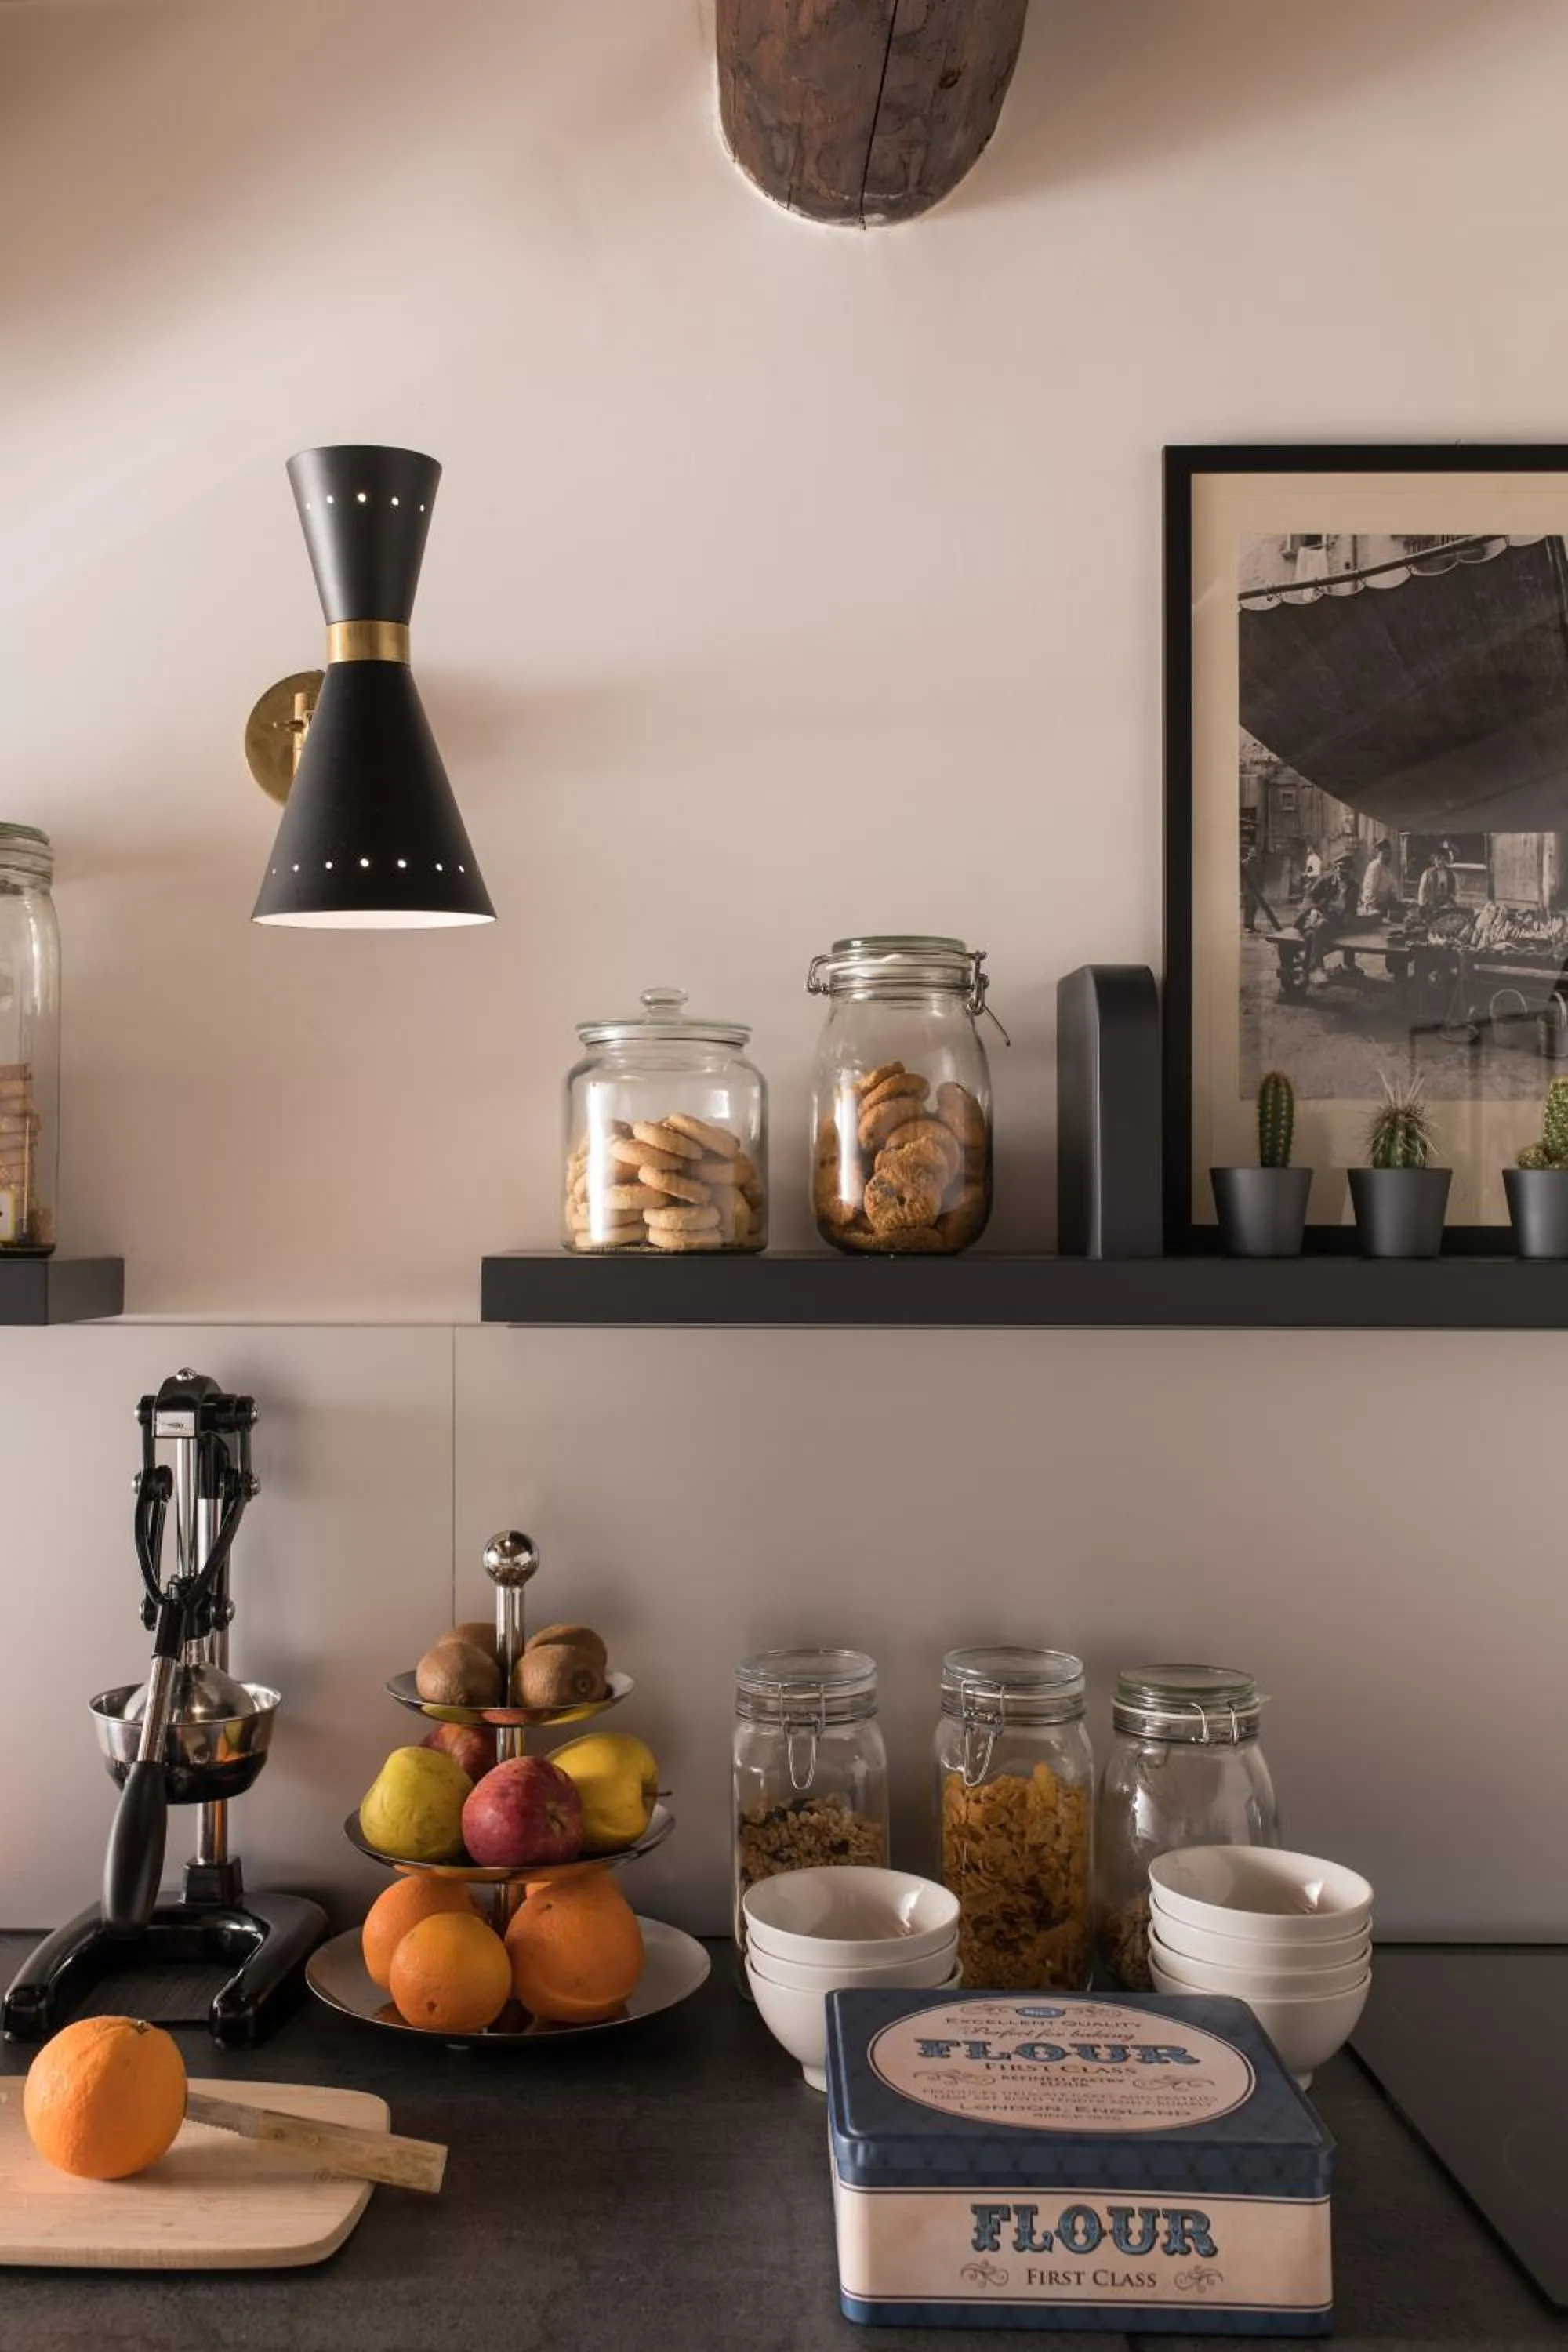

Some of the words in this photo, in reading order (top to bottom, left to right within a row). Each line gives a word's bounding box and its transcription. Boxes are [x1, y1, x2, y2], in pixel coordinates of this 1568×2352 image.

[946, 2018, 1056, 2027] EXCELLENT
[1061, 2020, 1142, 2029] QUALITY
[915, 2039, 1200, 2065] FLOUR
[985, 2063, 1052, 2072] FIRST
[1059, 2065, 1137, 2074] CLASS
[1075, 2106, 1190, 2116] ENGLAND
[971, 2204, 1218, 2258] FLOUR
[1026, 2268, 1085, 2286] FIRST
[1092, 2270, 1157, 2288] CLASS
